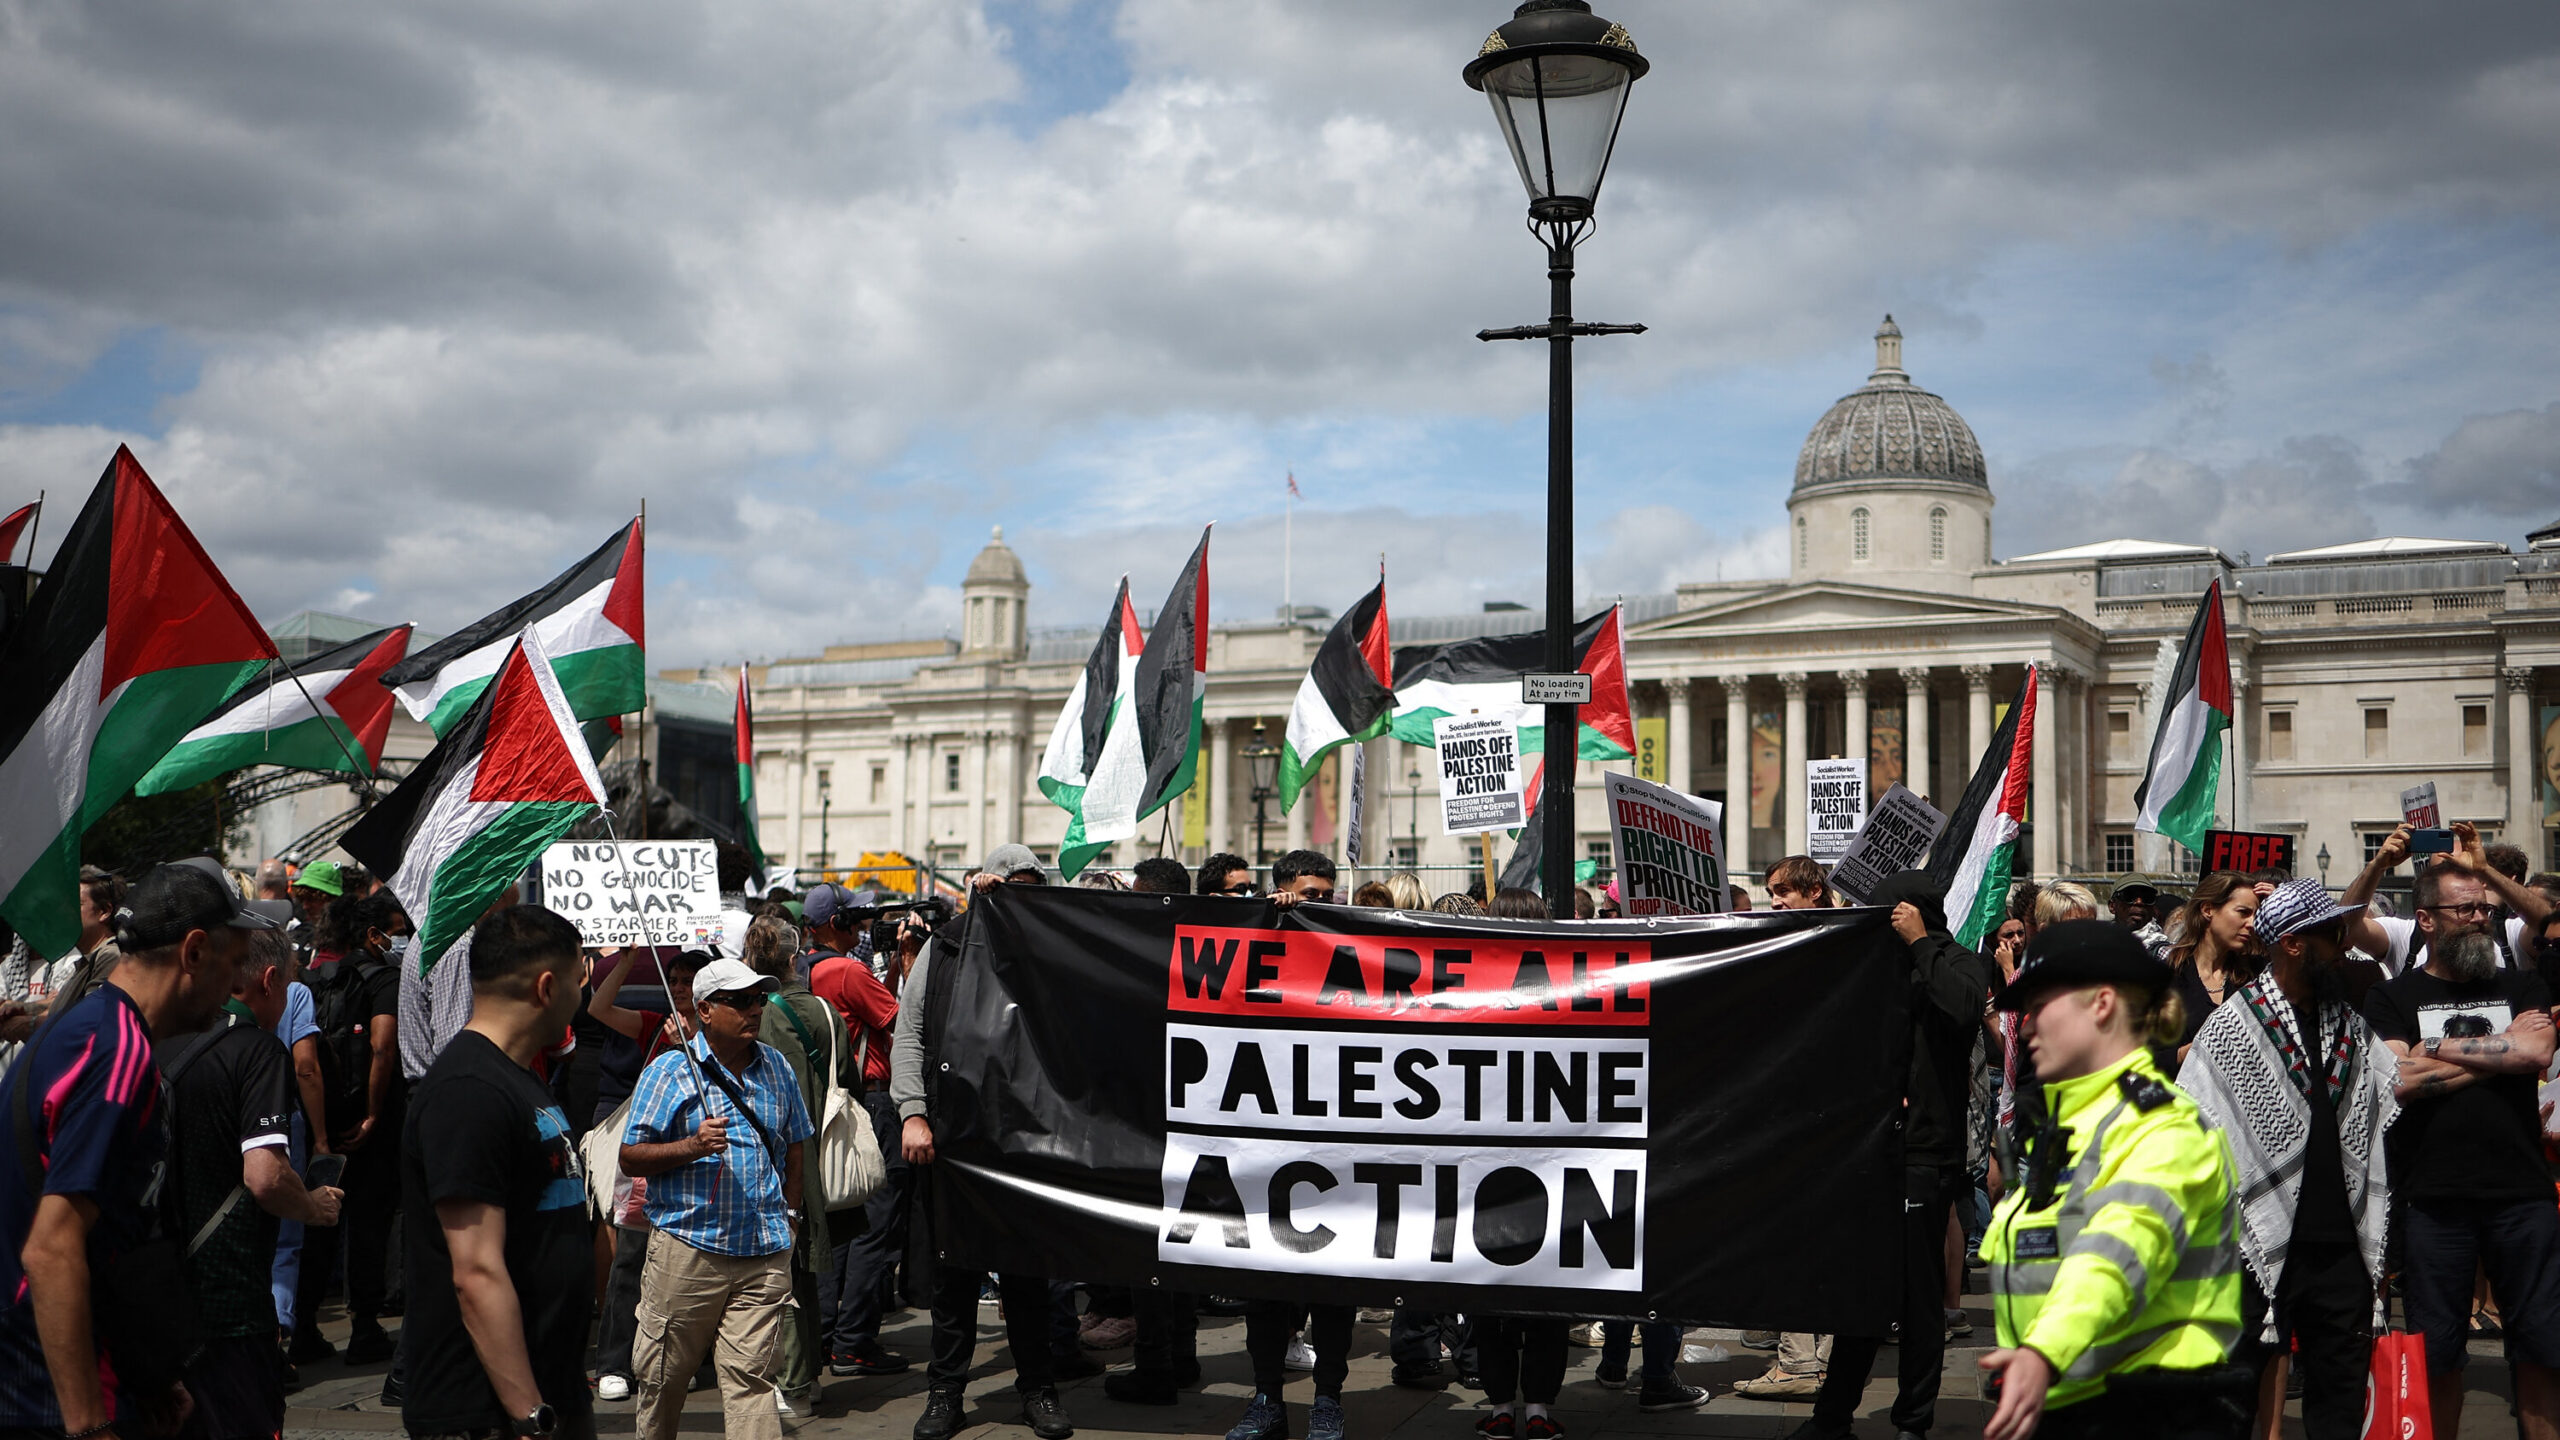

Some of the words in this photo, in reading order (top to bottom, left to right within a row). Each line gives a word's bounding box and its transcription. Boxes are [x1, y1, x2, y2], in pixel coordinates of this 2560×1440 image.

[1529, 690, 1540, 698] At
[1544, 691, 1561, 699] any
[1564, 690, 1580, 698] tim
[1531, 680, 1545, 688] No
[1549, 679, 1584, 689] loading
[1448, 721, 1477, 732] Socialist
[1477, 720, 1502, 728] Worker
[1441, 738, 1487, 760] HANDS
[1489, 735, 1513, 754] OFF
[1642, 737, 1654, 777] 200
[1444, 754, 1515, 778] PALESTINE
[1456, 774, 1506, 796] ACTION
[1811, 782, 1841, 798] HANDS
[1844, 781, 1861, 797] OFF
[1448, 799, 1479, 808] FREEDOM
[1448, 805, 1483, 815] PALESTINE
[1489, 802, 1516, 810] DEFEND
[1630, 787, 1649, 798] Stop
[1649, 793, 1661, 803] the
[1662, 797, 1676, 809] War
[1678, 805, 1711, 822] coalition
[1811, 798, 1861, 814] PALESTINE
[1449, 813, 1477, 822] PROTEST
[1479, 810, 1504, 818] RIGHTS
[1616, 799, 1683, 842] DEFEND
[1681, 819, 1715, 856] THE
[1818, 814, 1853, 830] ACTION
[1874, 806, 1913, 840] HANDS
[1907, 828, 1931, 852] OFF
[1863, 821, 1920, 869] PALESTINE
[2212, 833, 2284, 873] FREE
[572, 845, 615, 862] NO
[633, 847, 715, 875] CUTS
[1620, 827, 1689, 877] RIGHT
[1689, 848, 1720, 889] TO
[1846, 859, 1868, 877] FREEDOM
[1859, 844, 1902, 878] ACTION
[547, 869, 584, 888] NO
[601, 870, 705, 893] GENOCIDE
[1625, 863, 1721, 914] PROTEST
[553, 892, 593, 911] NO
[609, 894, 693, 914] WAR
[1629, 899, 1661, 915] DROP
[593, 917, 678, 931] STARMER
[582, 932, 604, 944] HAS
[608, 933, 640, 943] GOT
[644, 933, 661, 944] TO
[666, 932, 689, 943] GO
[1179, 936, 1286, 1004] WE
[1316, 945, 1473, 1011] ARE
[1502, 950, 1646, 1013] ALL
[1170, 1036, 1644, 1124] PALESTINE
[1165, 1154, 1638, 1270] ACTION
